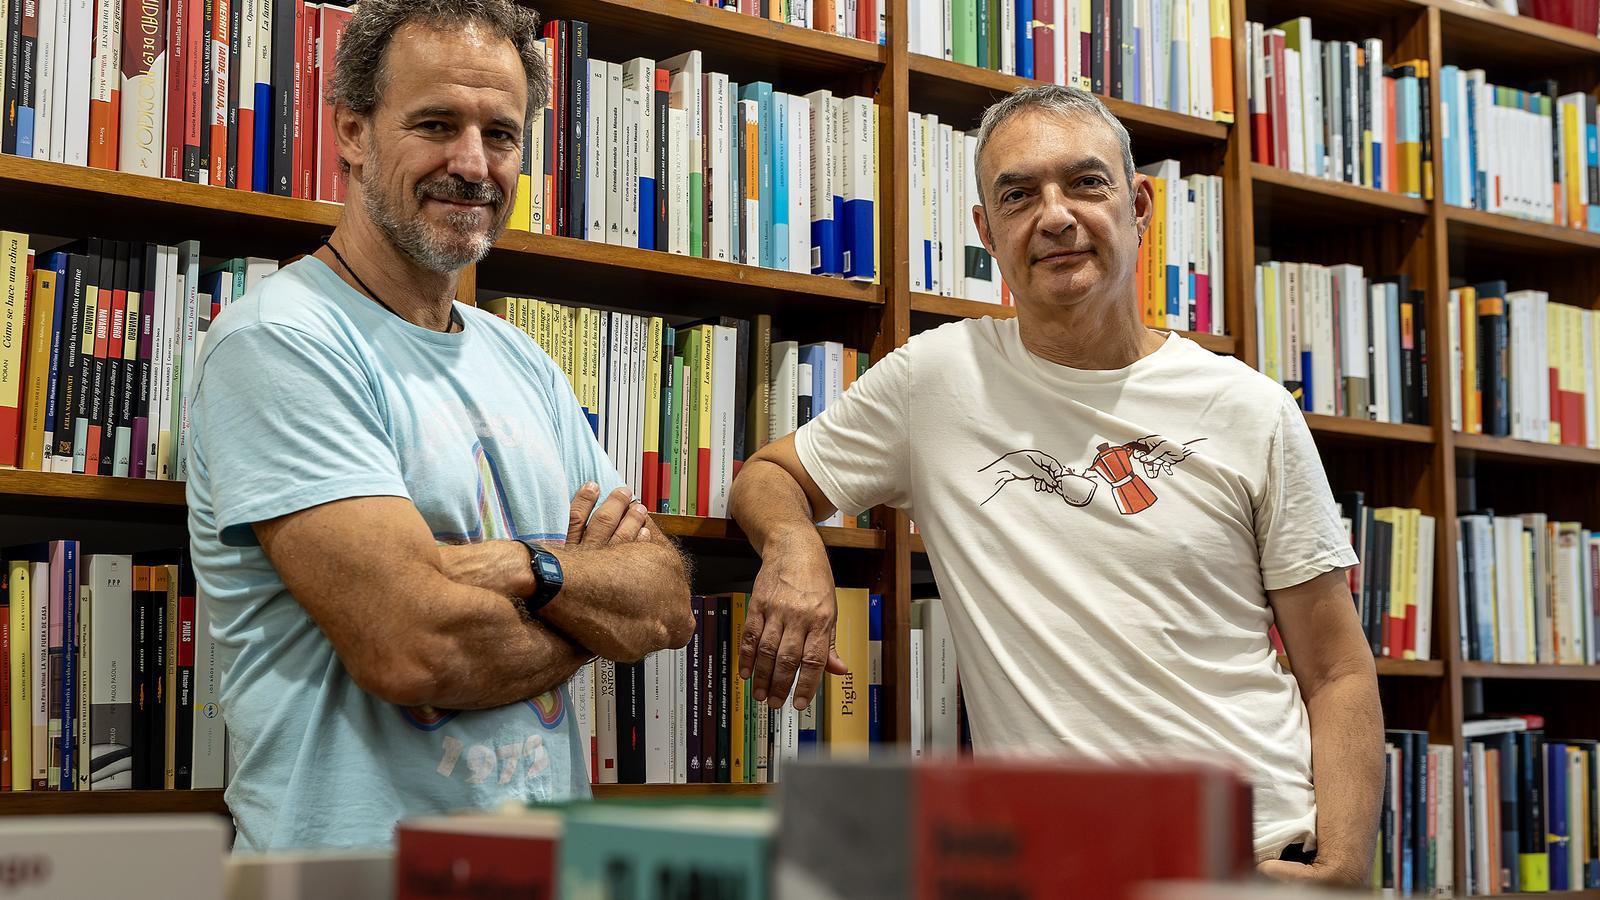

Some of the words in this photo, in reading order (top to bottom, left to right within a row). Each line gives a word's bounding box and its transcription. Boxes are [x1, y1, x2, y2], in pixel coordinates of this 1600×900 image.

[218, 1, 227, 40] MERRITT
[262, 21, 269, 31] La
[143, 39, 154, 50] DE
[7, 239, 18, 264] chica
[8, 266, 16, 283] una
[4, 285, 15, 307] hace
[6, 310, 13, 319] se
[84, 304, 94, 335] NAVARRO
[97, 309, 108, 339] NAVARRO
[112, 309, 123, 339] NAVARRO
[127, 311, 138, 341] NAVARRO
[2, 322, 12, 349] Cómo
[652, 320, 661, 363] Psicopompo
[703, 329, 711, 371] vulnerables
[182, 621, 191, 642] PAULS
[601, 686, 607, 695] YO
[840, 671, 856, 716] Piglia
